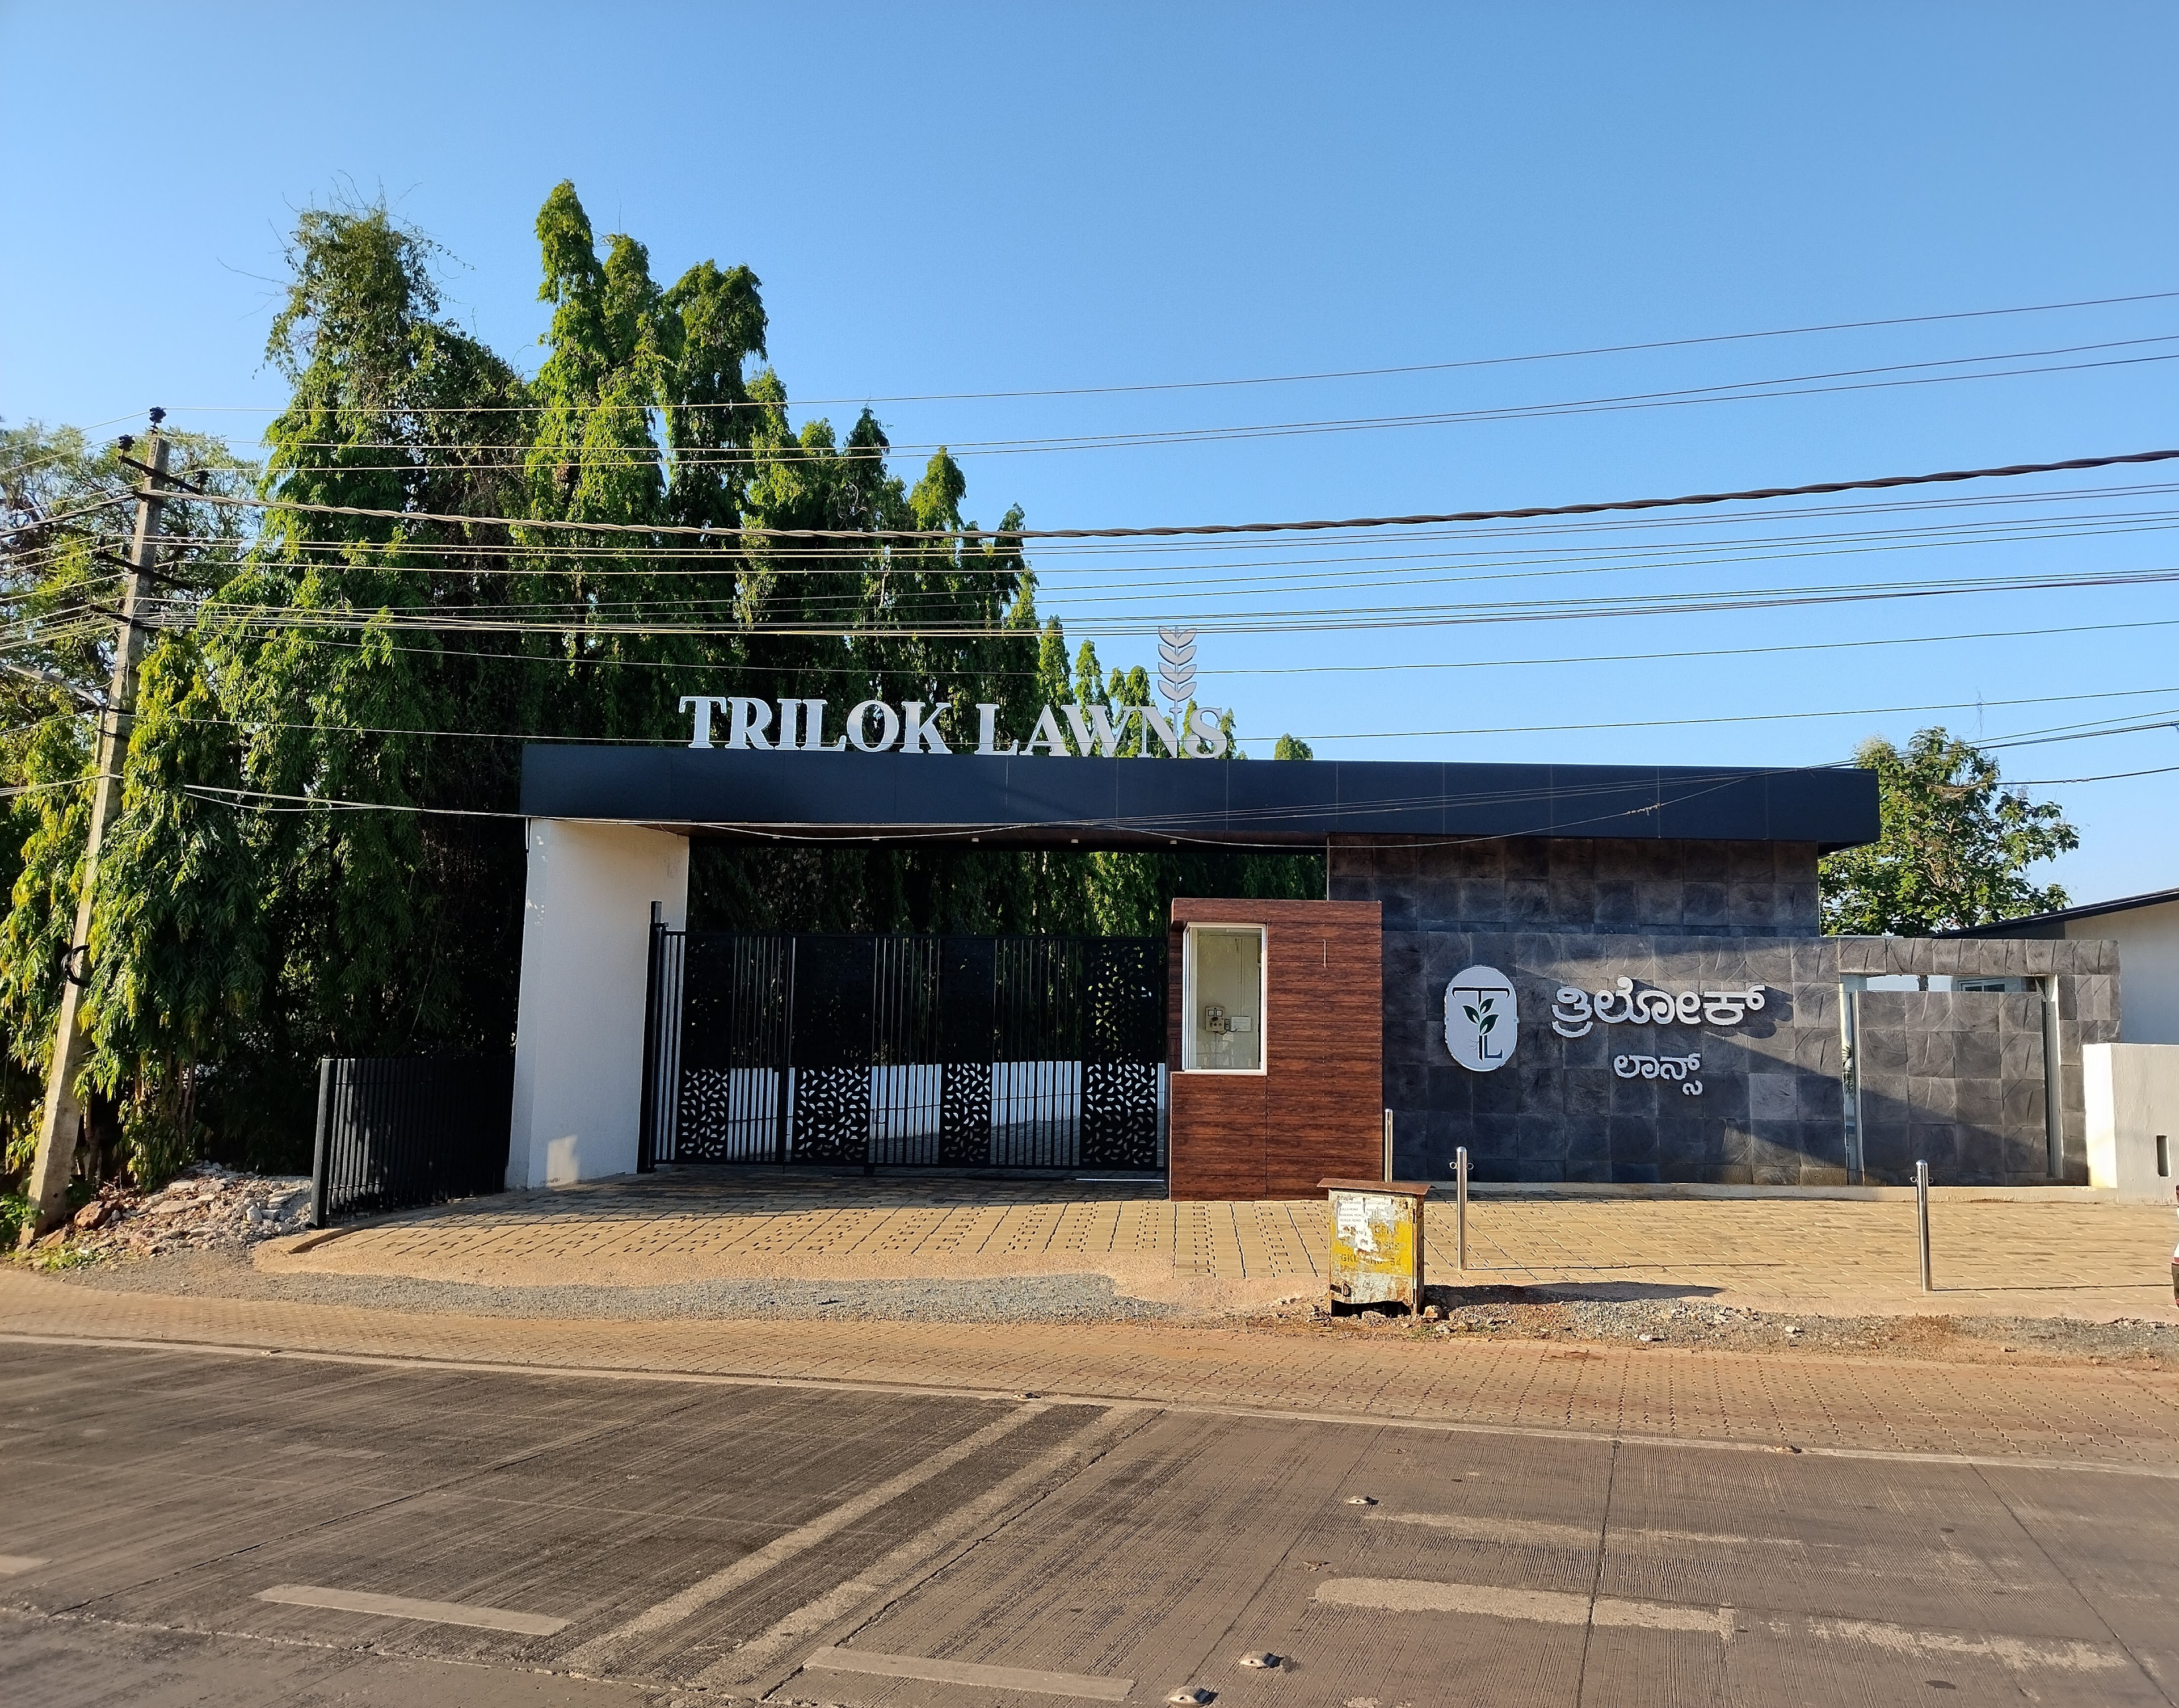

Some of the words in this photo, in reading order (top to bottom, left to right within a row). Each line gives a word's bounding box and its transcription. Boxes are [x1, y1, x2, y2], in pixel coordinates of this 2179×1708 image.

[678, 695, 952, 754] TRILOK
[975, 704, 1229, 759] LAWNS
[1551, 975, 1766, 1038] ತ್ರಿಲೋಕ್
[1613, 1052, 1703, 1096] ಲಾನ್ಸ್
